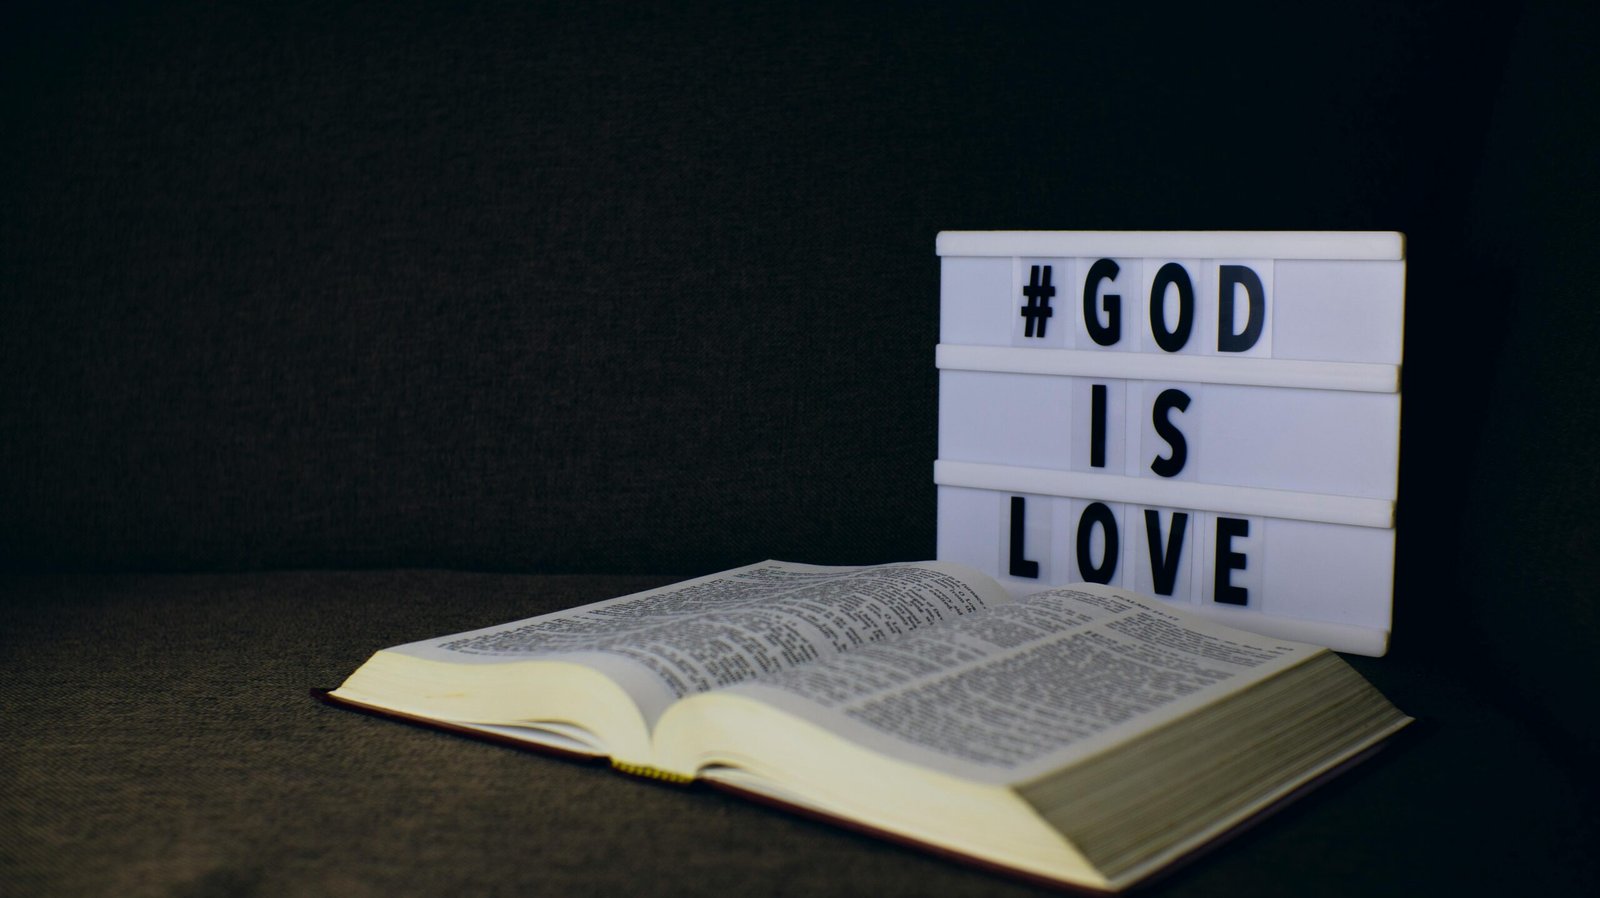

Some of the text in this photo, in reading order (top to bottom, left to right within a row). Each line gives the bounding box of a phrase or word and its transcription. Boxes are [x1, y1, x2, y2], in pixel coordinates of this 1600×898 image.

[1020, 257, 1265, 353] #GOD
[1090, 384, 1192, 478] IS
[1008, 495, 1250, 607] LOVE
